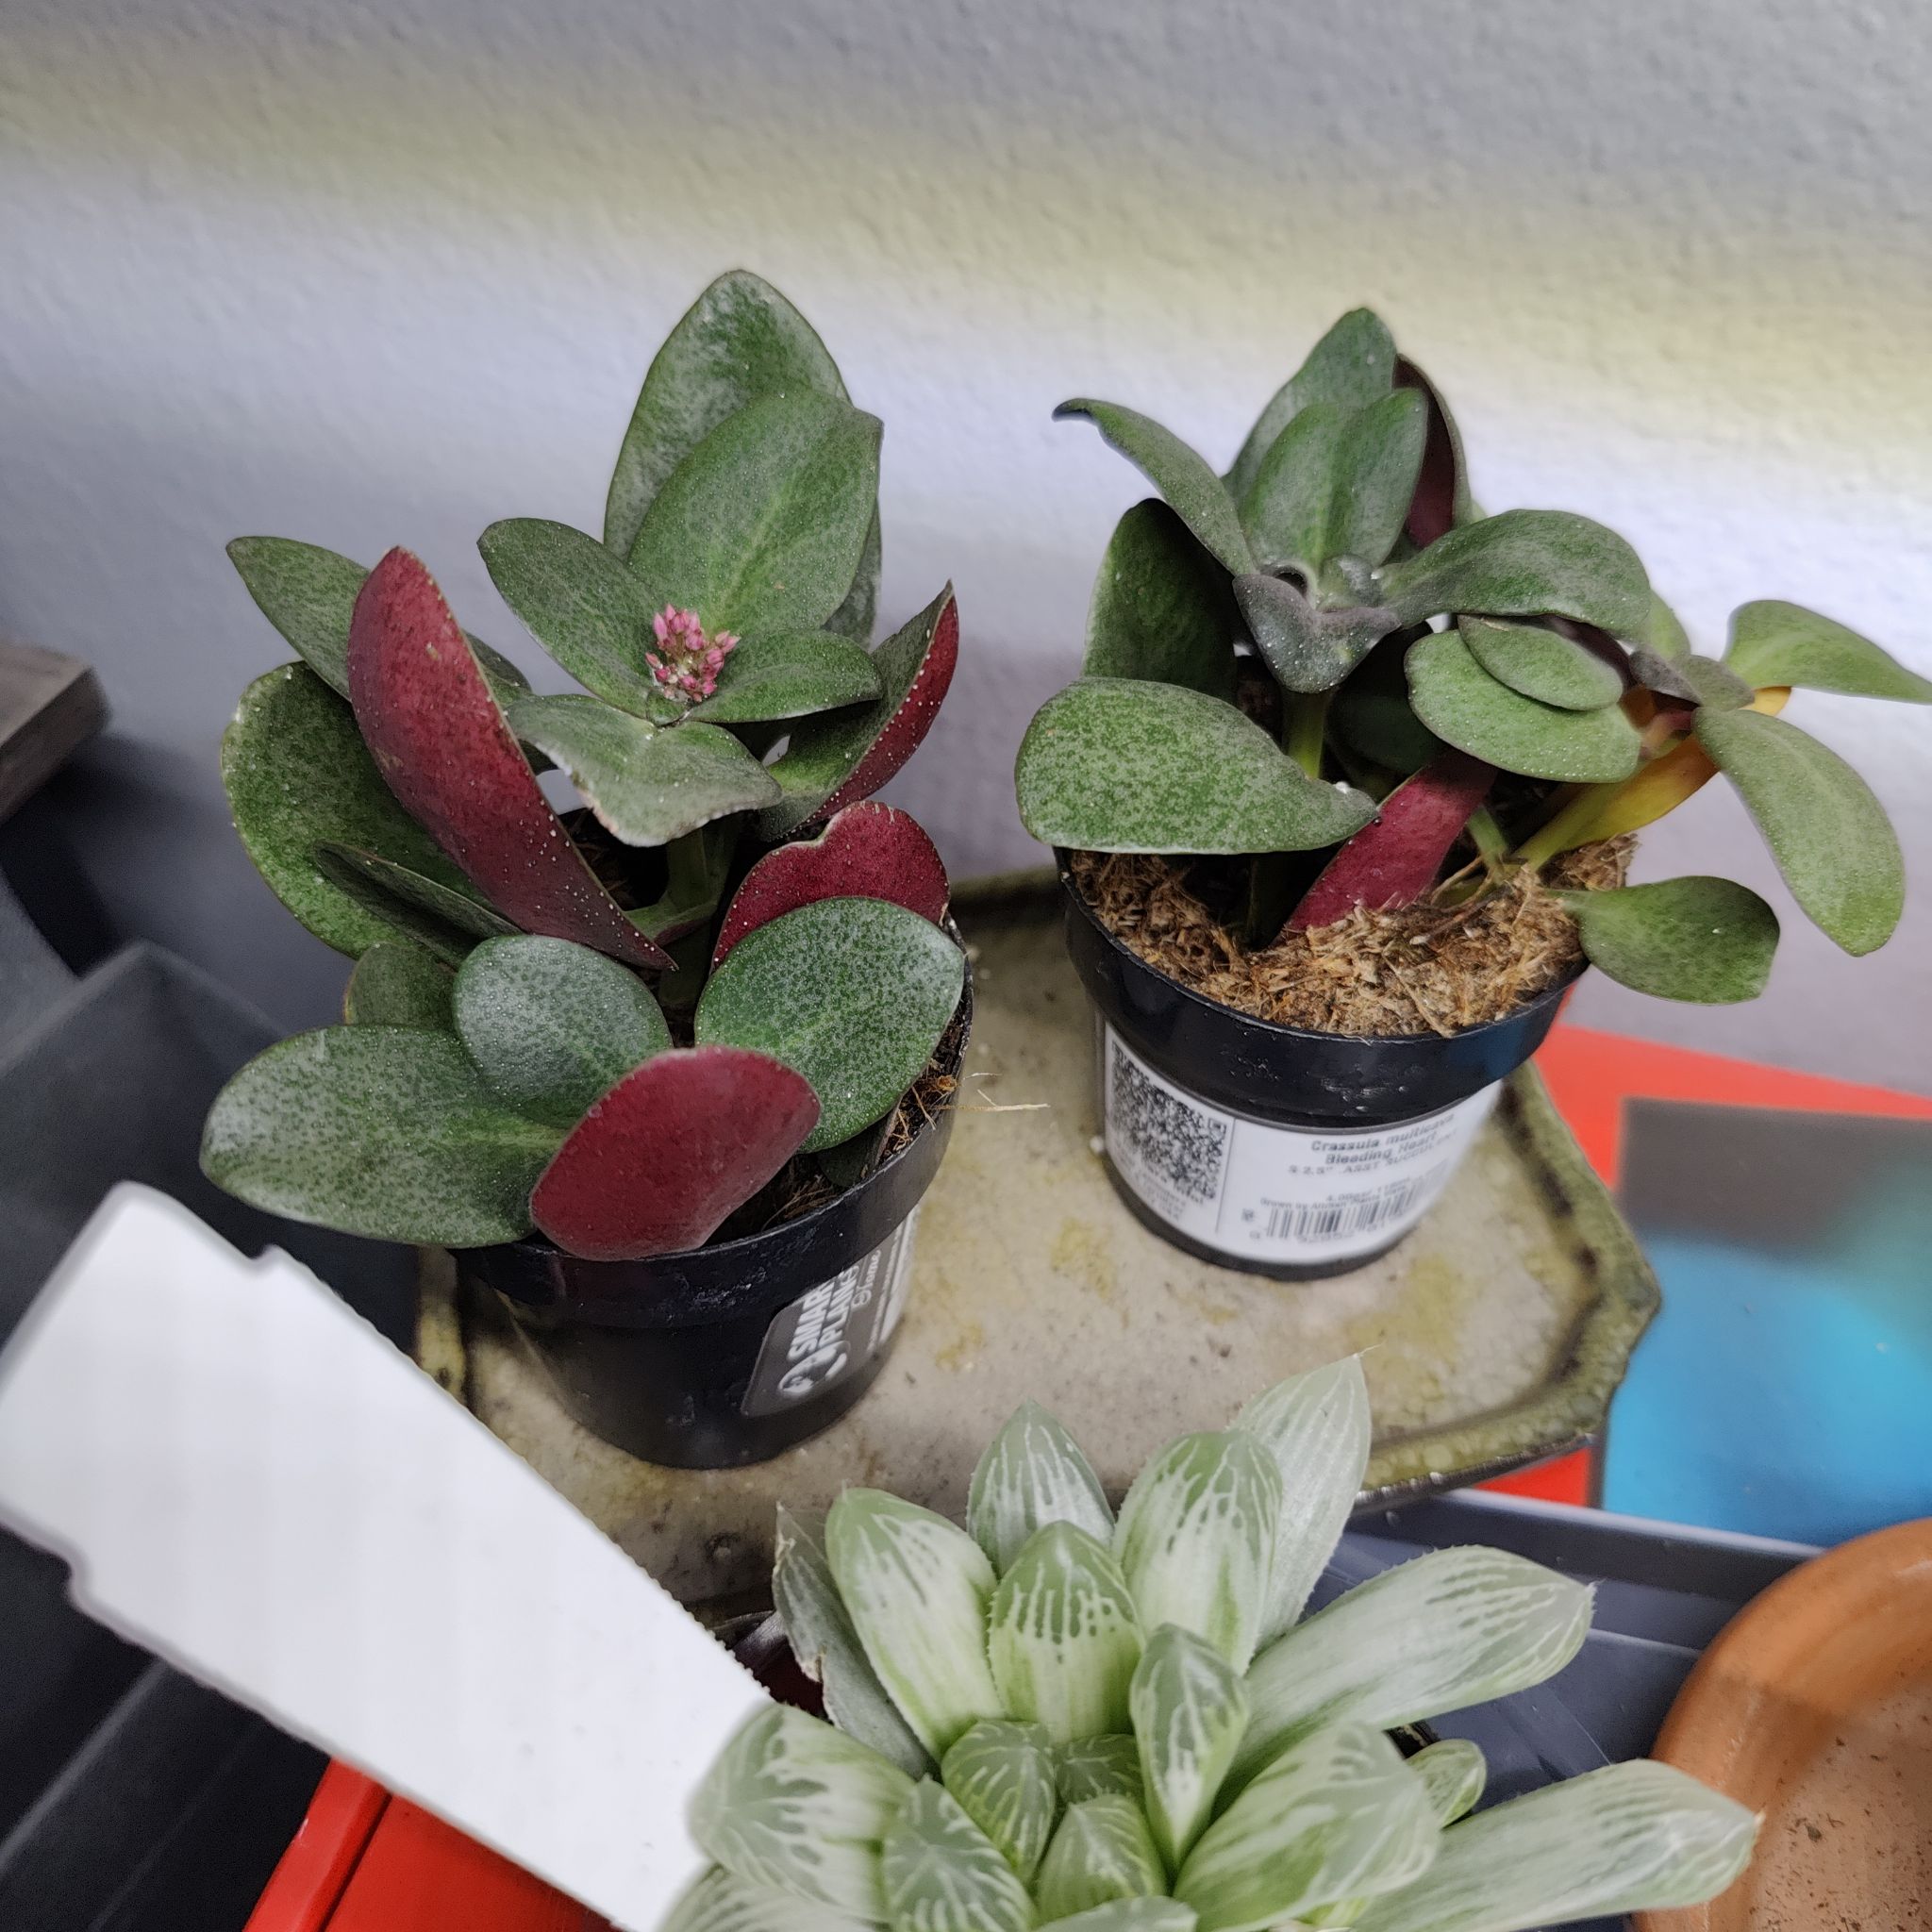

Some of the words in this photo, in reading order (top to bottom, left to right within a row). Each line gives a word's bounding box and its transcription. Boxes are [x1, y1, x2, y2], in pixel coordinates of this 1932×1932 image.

[1311, 1140, 1379, 1152] Crassula
[1325, 1149, 1393, 1165] Bleeding
[1398, 1131, 1437, 1154] Heart
